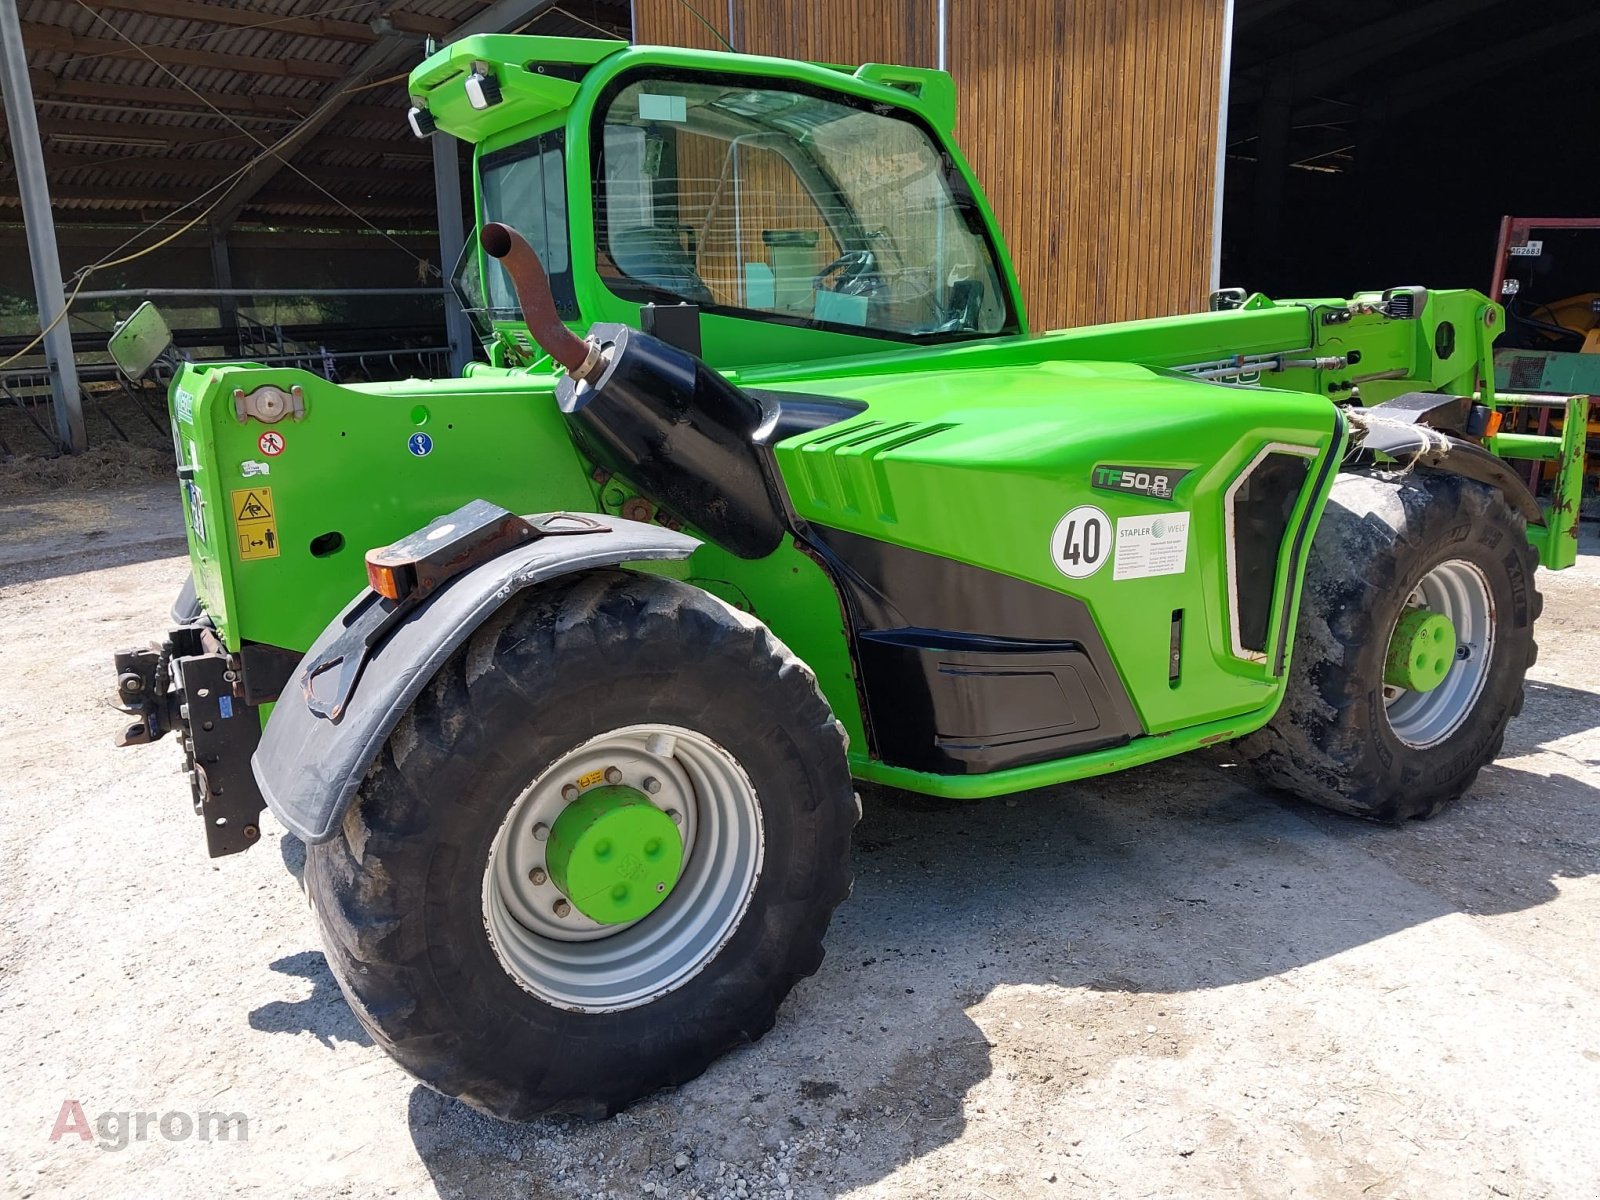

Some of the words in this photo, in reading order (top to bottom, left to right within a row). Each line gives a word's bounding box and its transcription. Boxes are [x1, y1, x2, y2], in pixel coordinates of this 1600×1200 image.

[1096, 467, 1168, 492] TF50.8
[1063, 518, 1100, 566] 40
[1120, 527, 1151, 538] STAPLER
[1167, 524, 1186, 534] WELT
